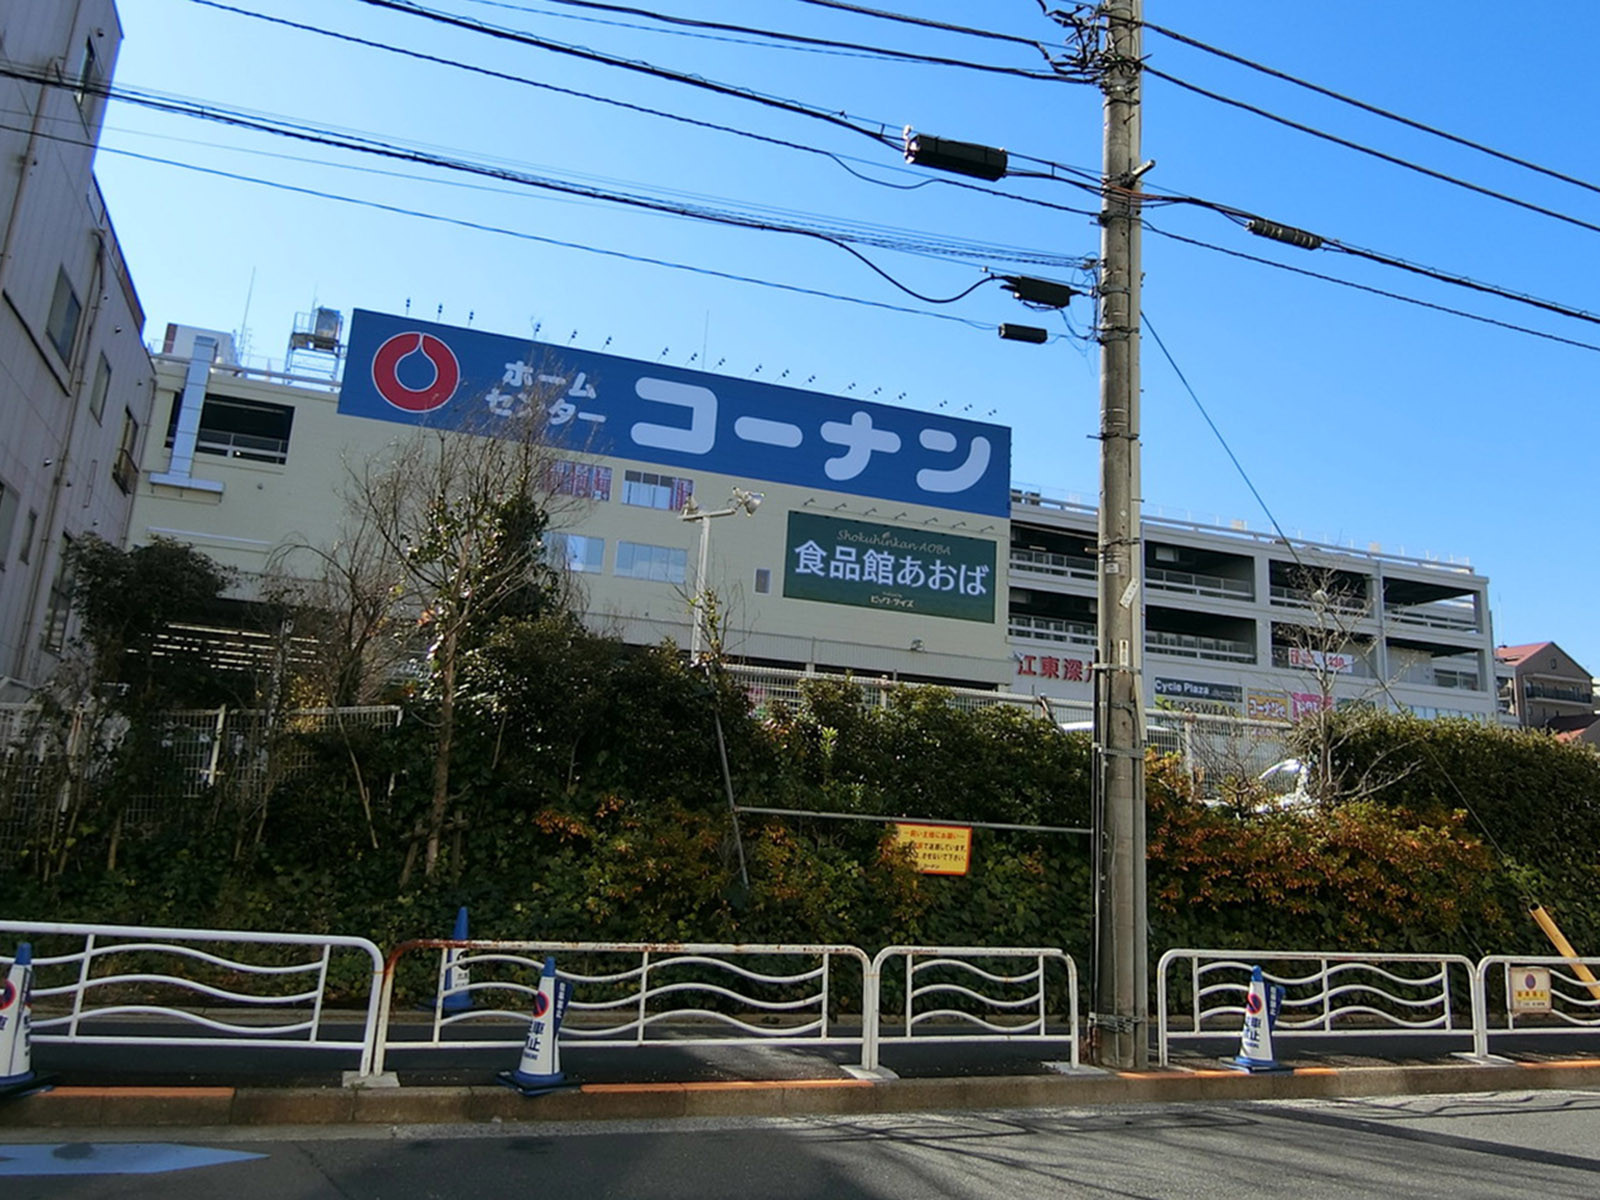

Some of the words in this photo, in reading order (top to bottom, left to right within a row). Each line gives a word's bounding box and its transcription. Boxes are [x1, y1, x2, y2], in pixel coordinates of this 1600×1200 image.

[502, 360, 597, 399] ホーム
[485, 387, 607, 425] センター
[630, 376, 991, 493] コーナン
[836, 529, 919, 551] Shokuhinkan
[920, 542, 952, 556] AOBA
[794, 540, 990, 596] 食品館あおば
[1017, 654, 1093, 683] 江東深
[1155, 679, 1182, 693] Cycle
[1183, 682, 1210, 695] Plaza
